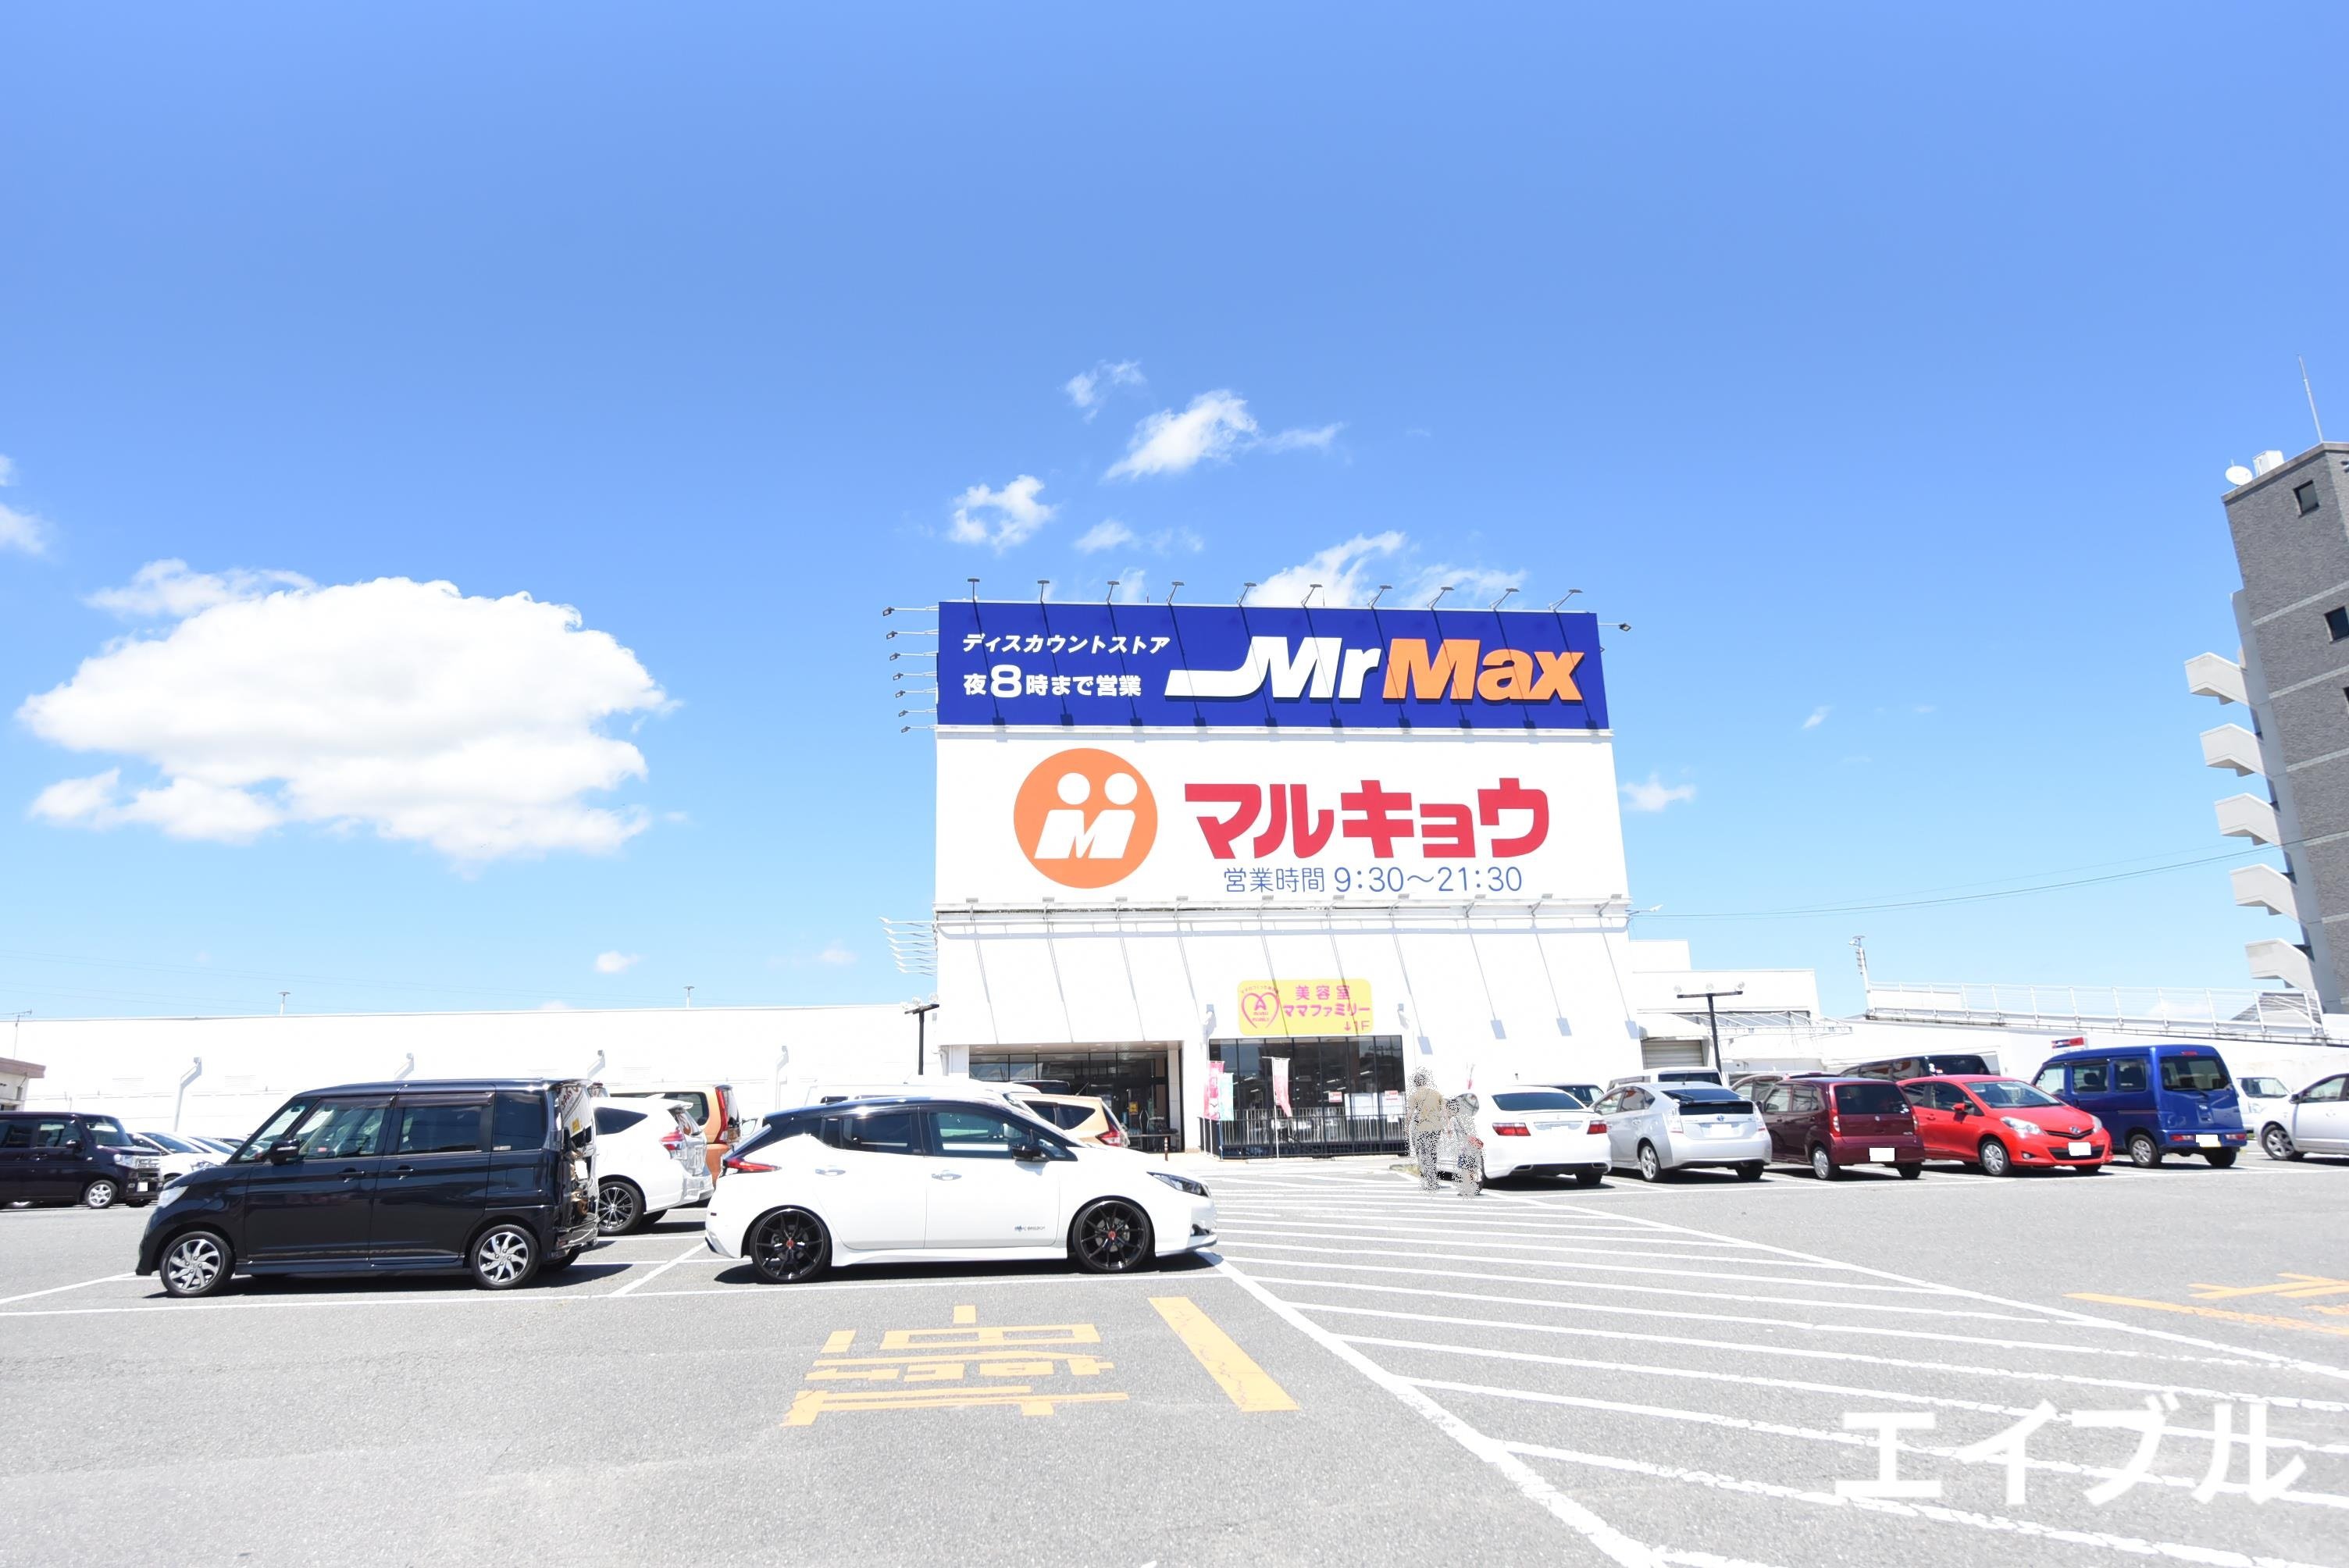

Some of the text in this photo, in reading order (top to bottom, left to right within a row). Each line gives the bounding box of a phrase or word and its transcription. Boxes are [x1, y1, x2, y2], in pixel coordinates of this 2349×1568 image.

[963, 633, 1171, 654] ディスカウントストア
[964, 665, 1142, 697] 夜8時まで営業
[1185, 778, 1549, 859] マルキョウ
[1224, 867, 1325, 893] 営業時間
[1296, 985, 1350, 1000] 美容室
[1283, 1003, 1371, 1017] ママファミリー
